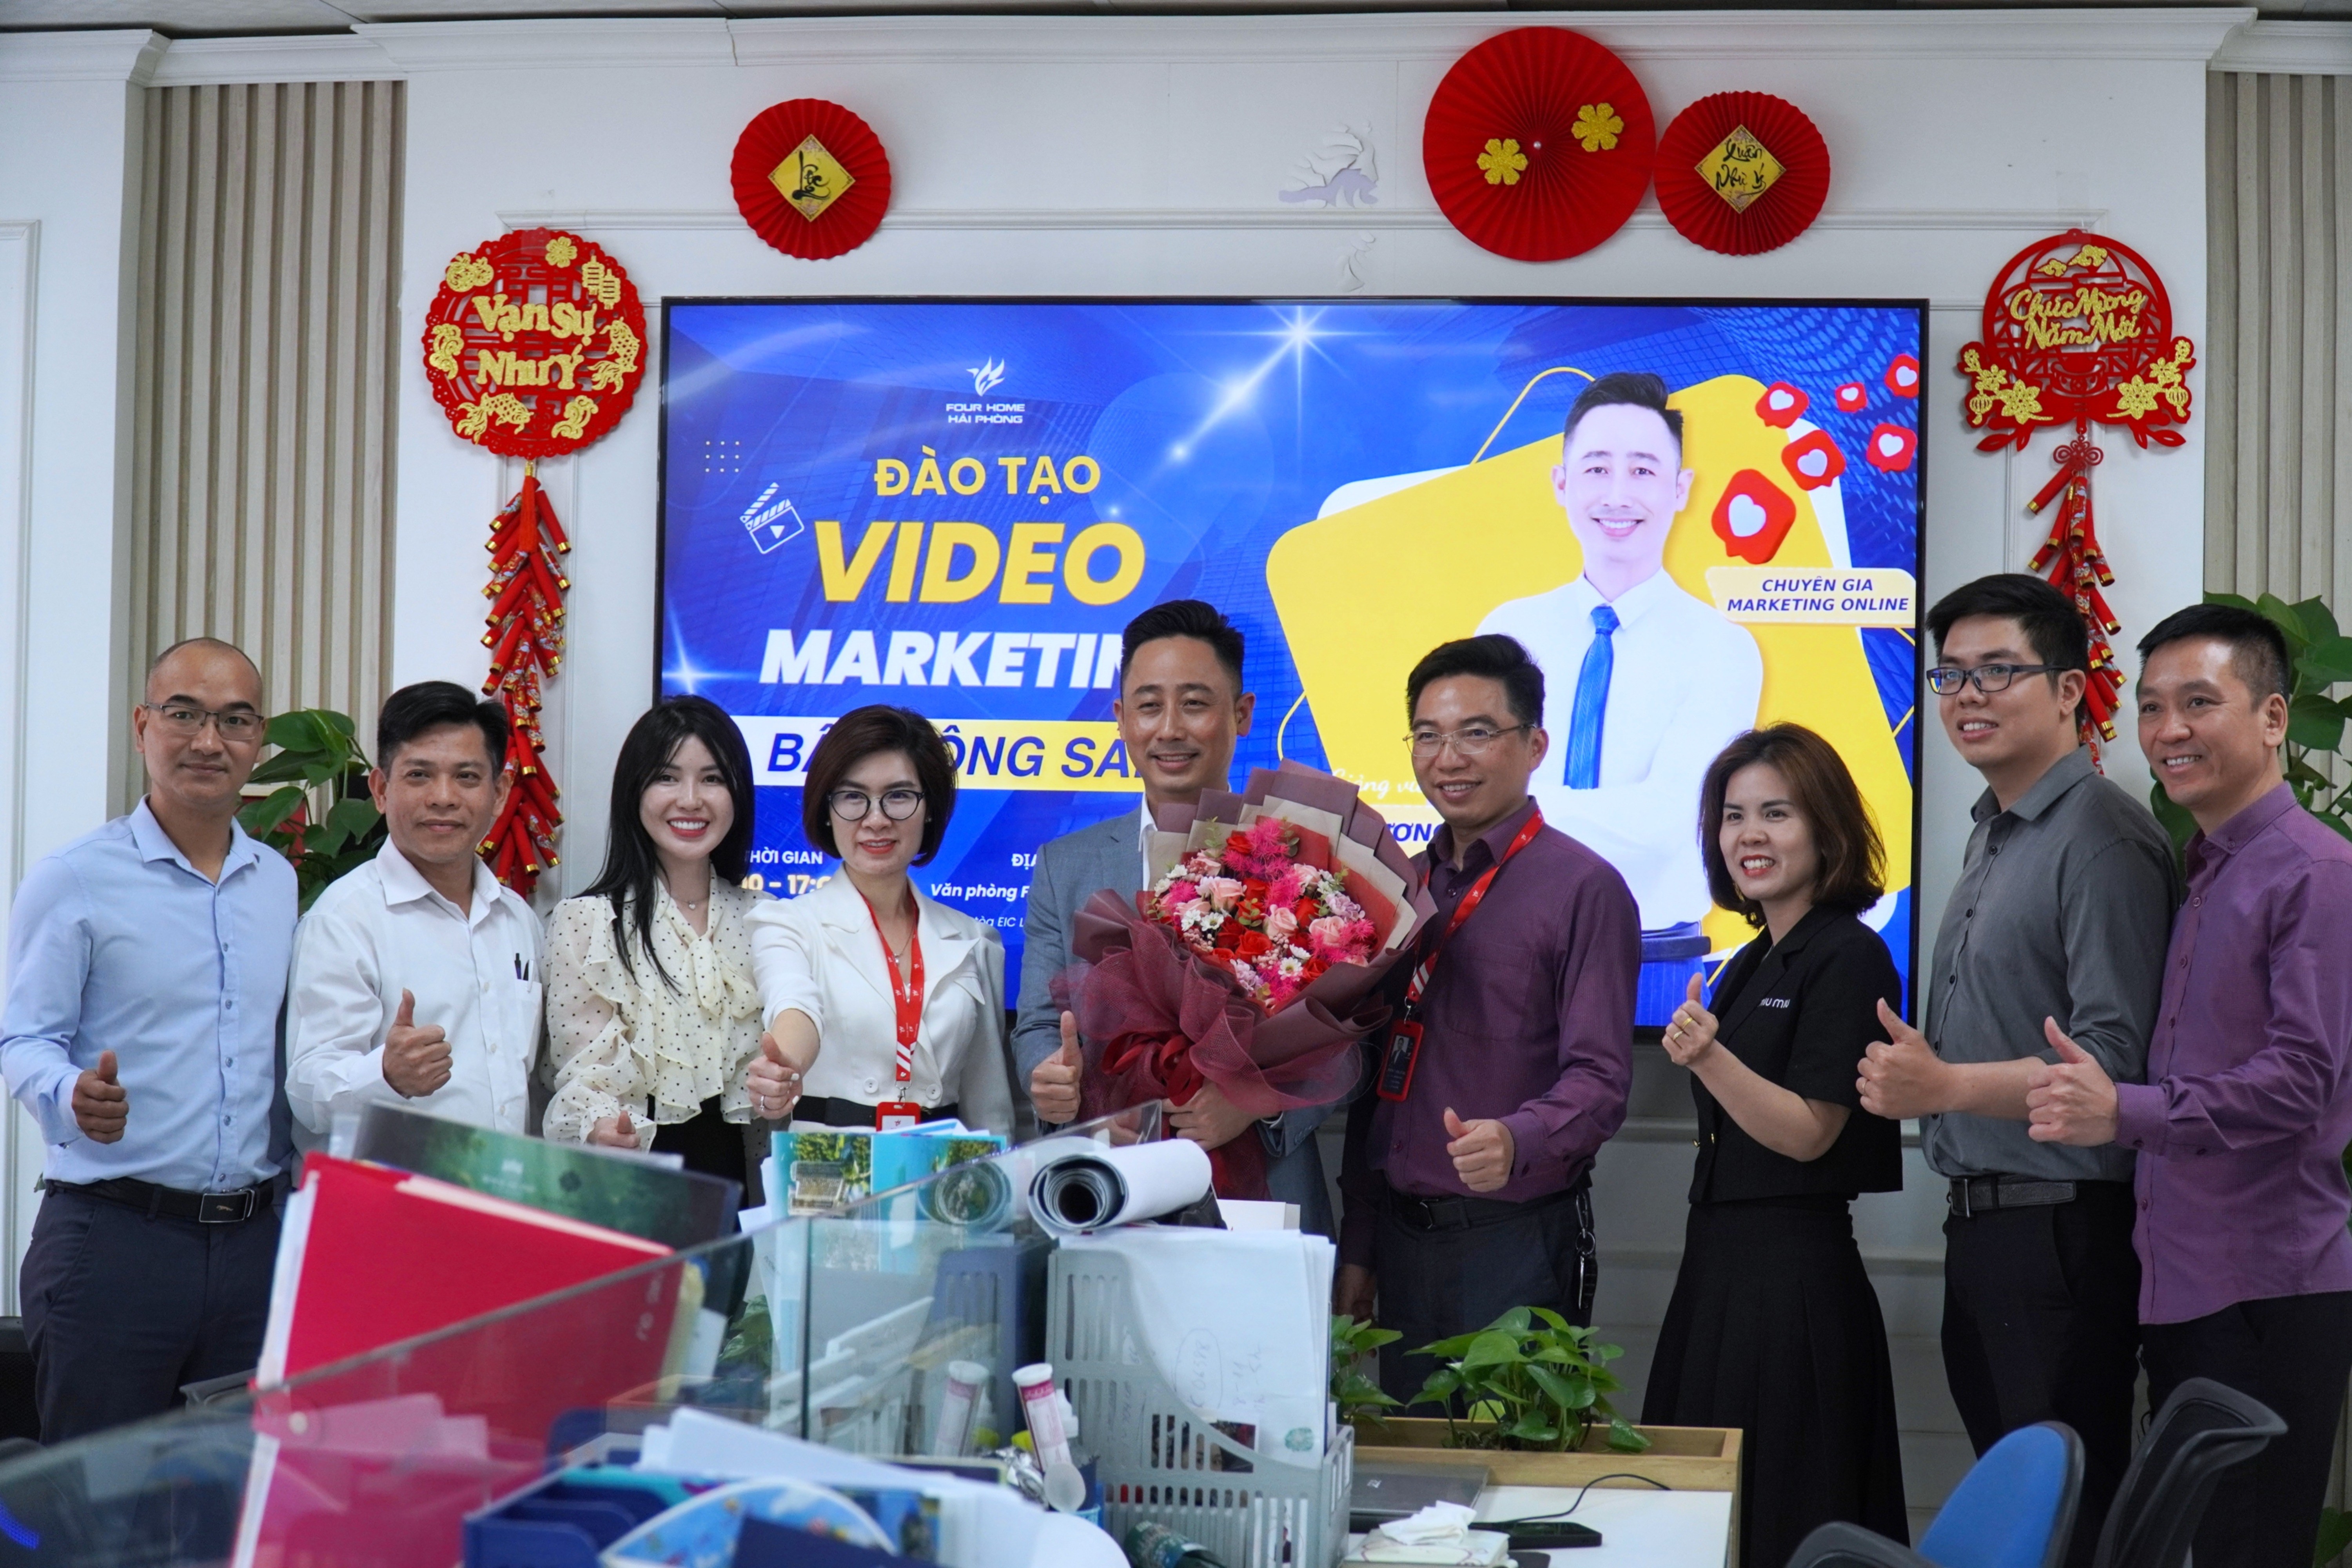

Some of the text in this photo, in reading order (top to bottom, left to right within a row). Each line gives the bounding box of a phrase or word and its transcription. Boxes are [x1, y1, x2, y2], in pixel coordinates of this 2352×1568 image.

[946, 403, 1025, 412] FOUR HOME
[948, 413, 1023, 424] HẢI PHÒNG
[874, 445, 1100, 505] ĐÀO TẠO
[815, 521, 1146, 606] VIDEO
[1762, 575, 1873, 592] CHUYÊN GIA
[1727, 598, 1908, 611] MARKETING ONLINE
[759, 629, 1122, 689] MARKETIN
[941, 725, 1045, 777] ÔNG
[1061, 737, 1142, 778] SA
[746, 846, 823, 864] HỜI GIAN
[931, 883, 962, 897] Văn
[965, 883, 1018, 902] phòng
[997, 916, 1016, 927] EIC
